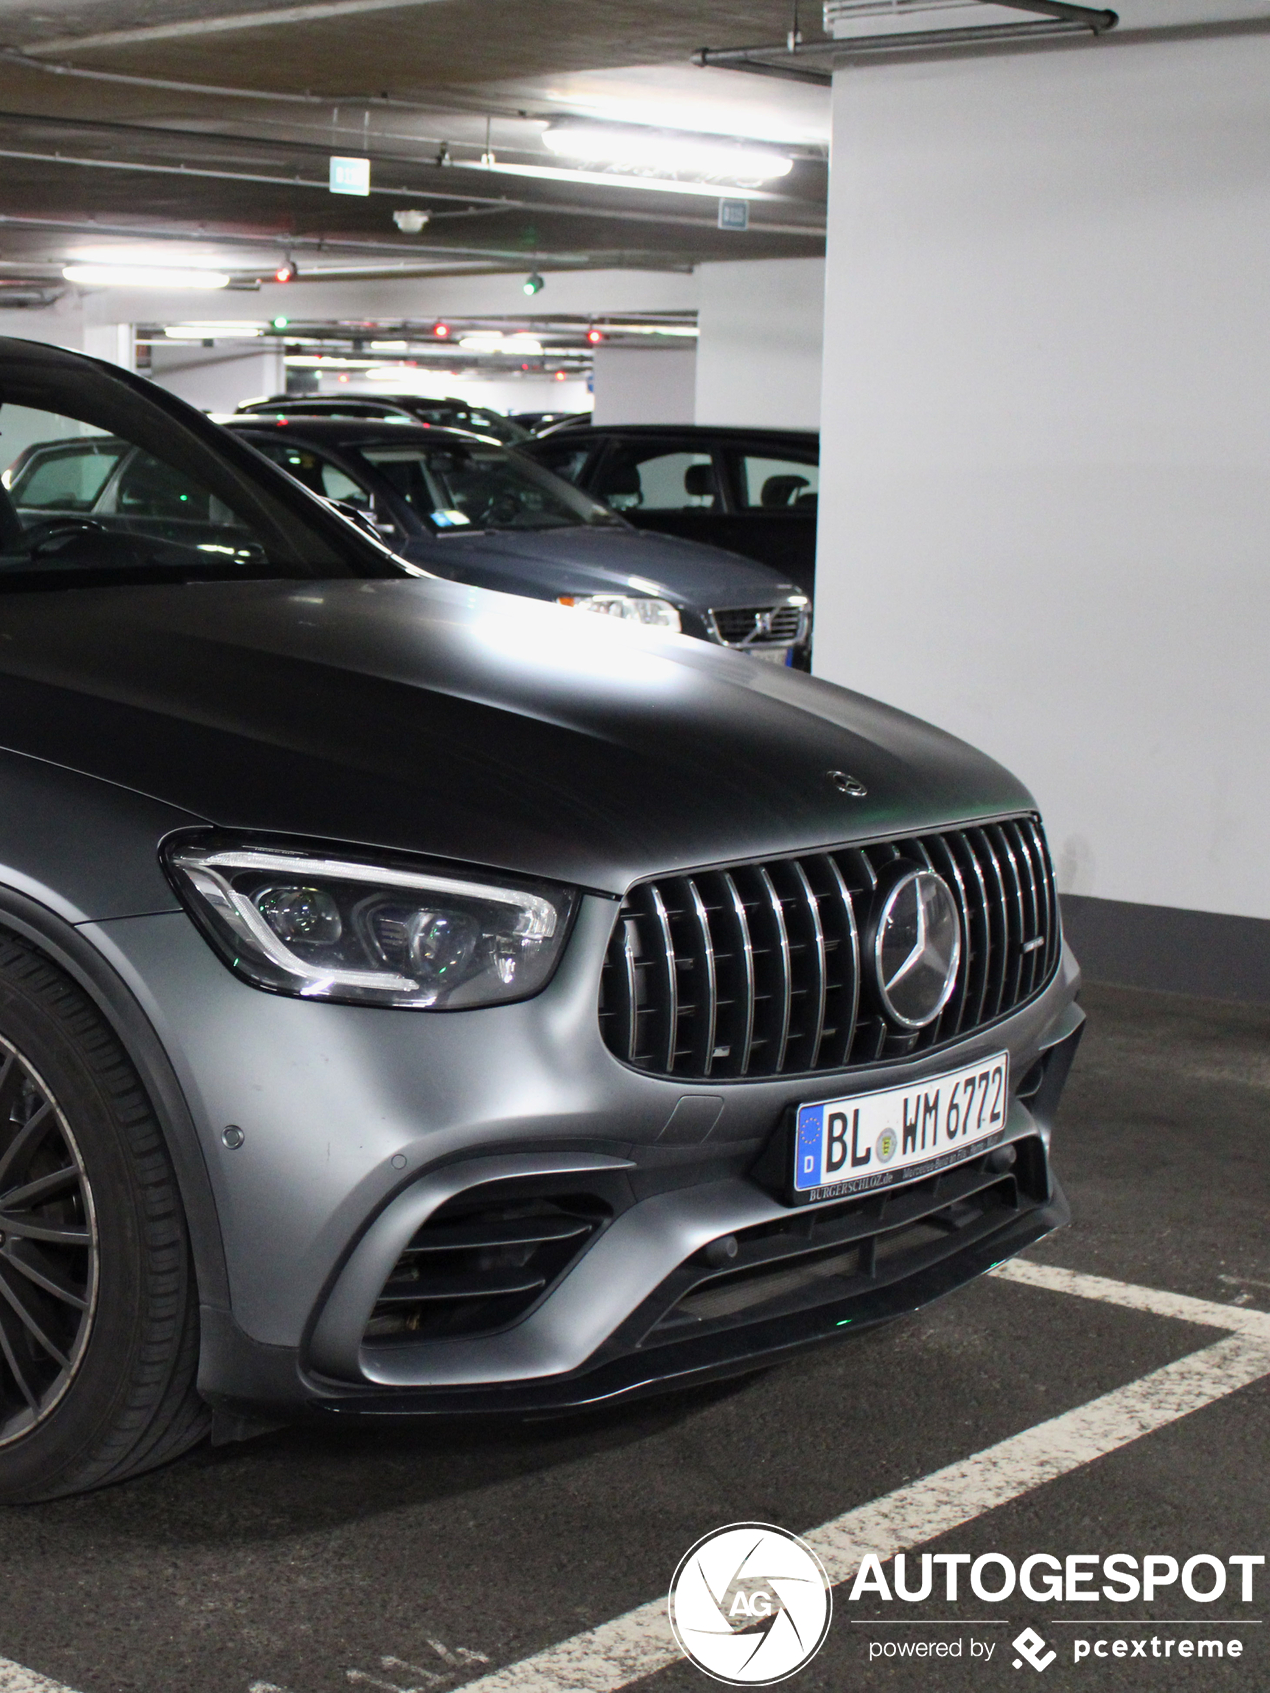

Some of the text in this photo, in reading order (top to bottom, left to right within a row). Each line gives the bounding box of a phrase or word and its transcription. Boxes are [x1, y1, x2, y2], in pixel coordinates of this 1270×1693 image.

[825, 1065, 1003, 1174] BL WM 6772
[803, 1155, 815, 1174] D
